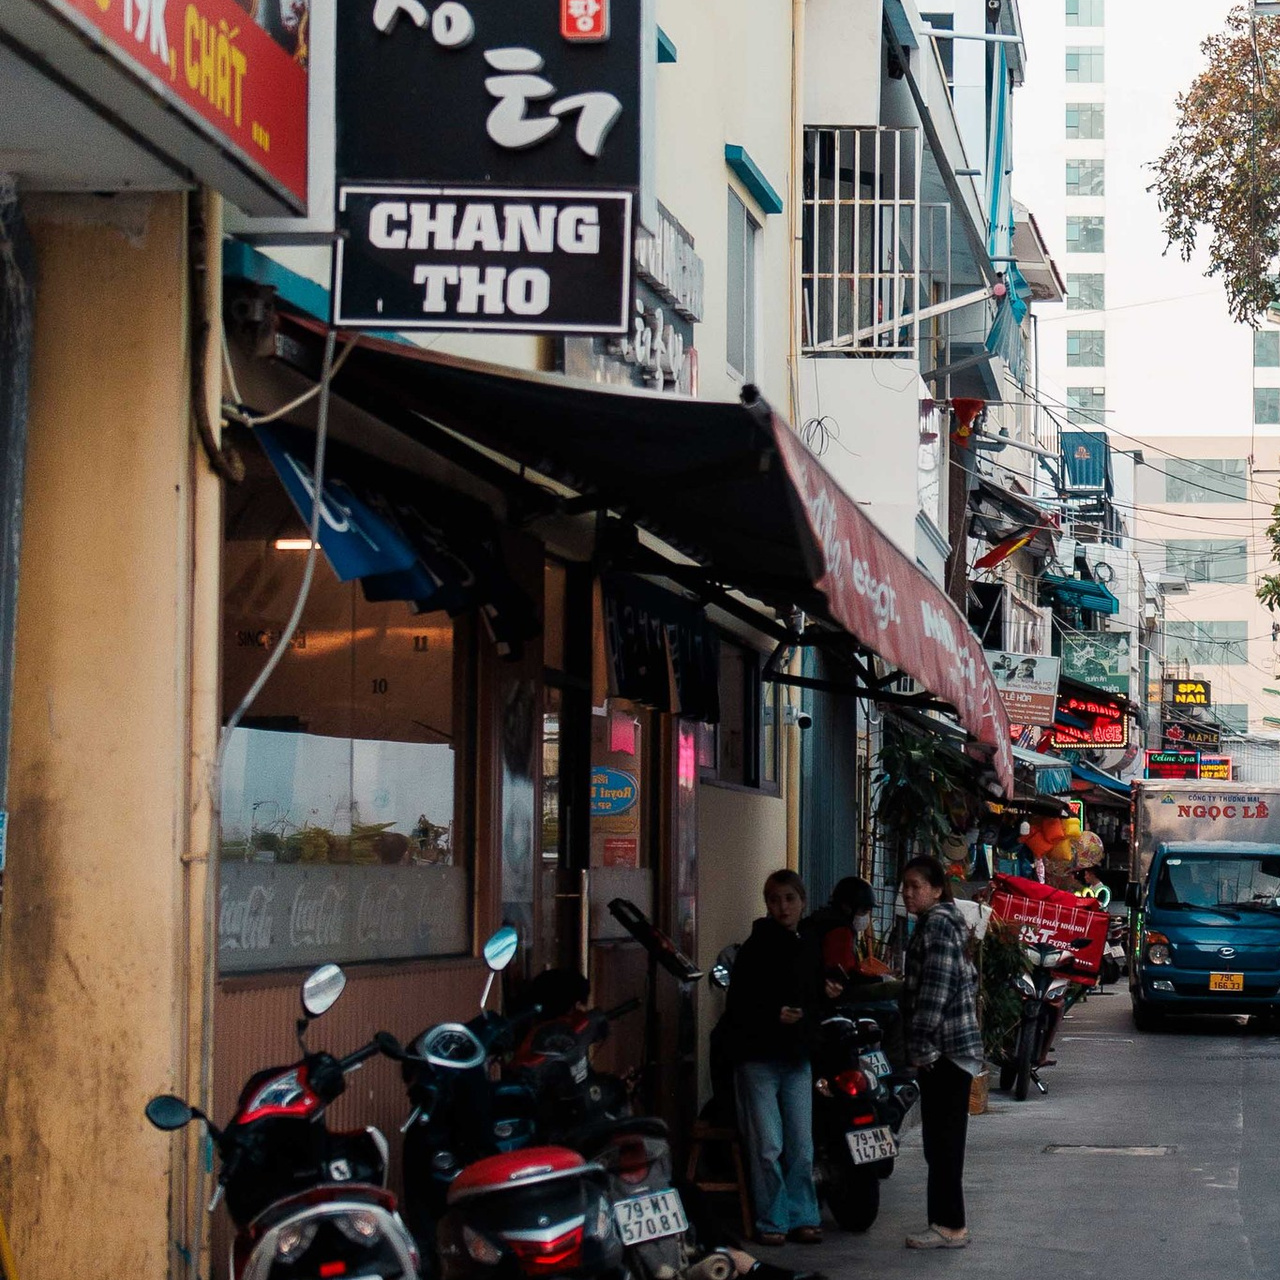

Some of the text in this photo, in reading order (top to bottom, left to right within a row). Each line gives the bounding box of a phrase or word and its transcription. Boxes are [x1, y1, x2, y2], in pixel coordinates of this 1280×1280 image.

[368, 201, 601, 254] CHANG
[413, 264, 551, 315] THO
[371, 678, 388, 694] 10
[1178, 683, 1205, 693] SPA
[1175, 694, 1208, 704] NAIL
[1188, 732, 1218, 743] MAPLE
[1151, 753, 1177, 763] Celine
[1178, 754, 1196, 765] Spa
[1188, 794, 1206, 802] CÔNG
[1177, 805, 1237, 820] NGỌC
[1061, 923, 1085, 933] NHANH
[624, 1213, 683, 1241] 570.81
